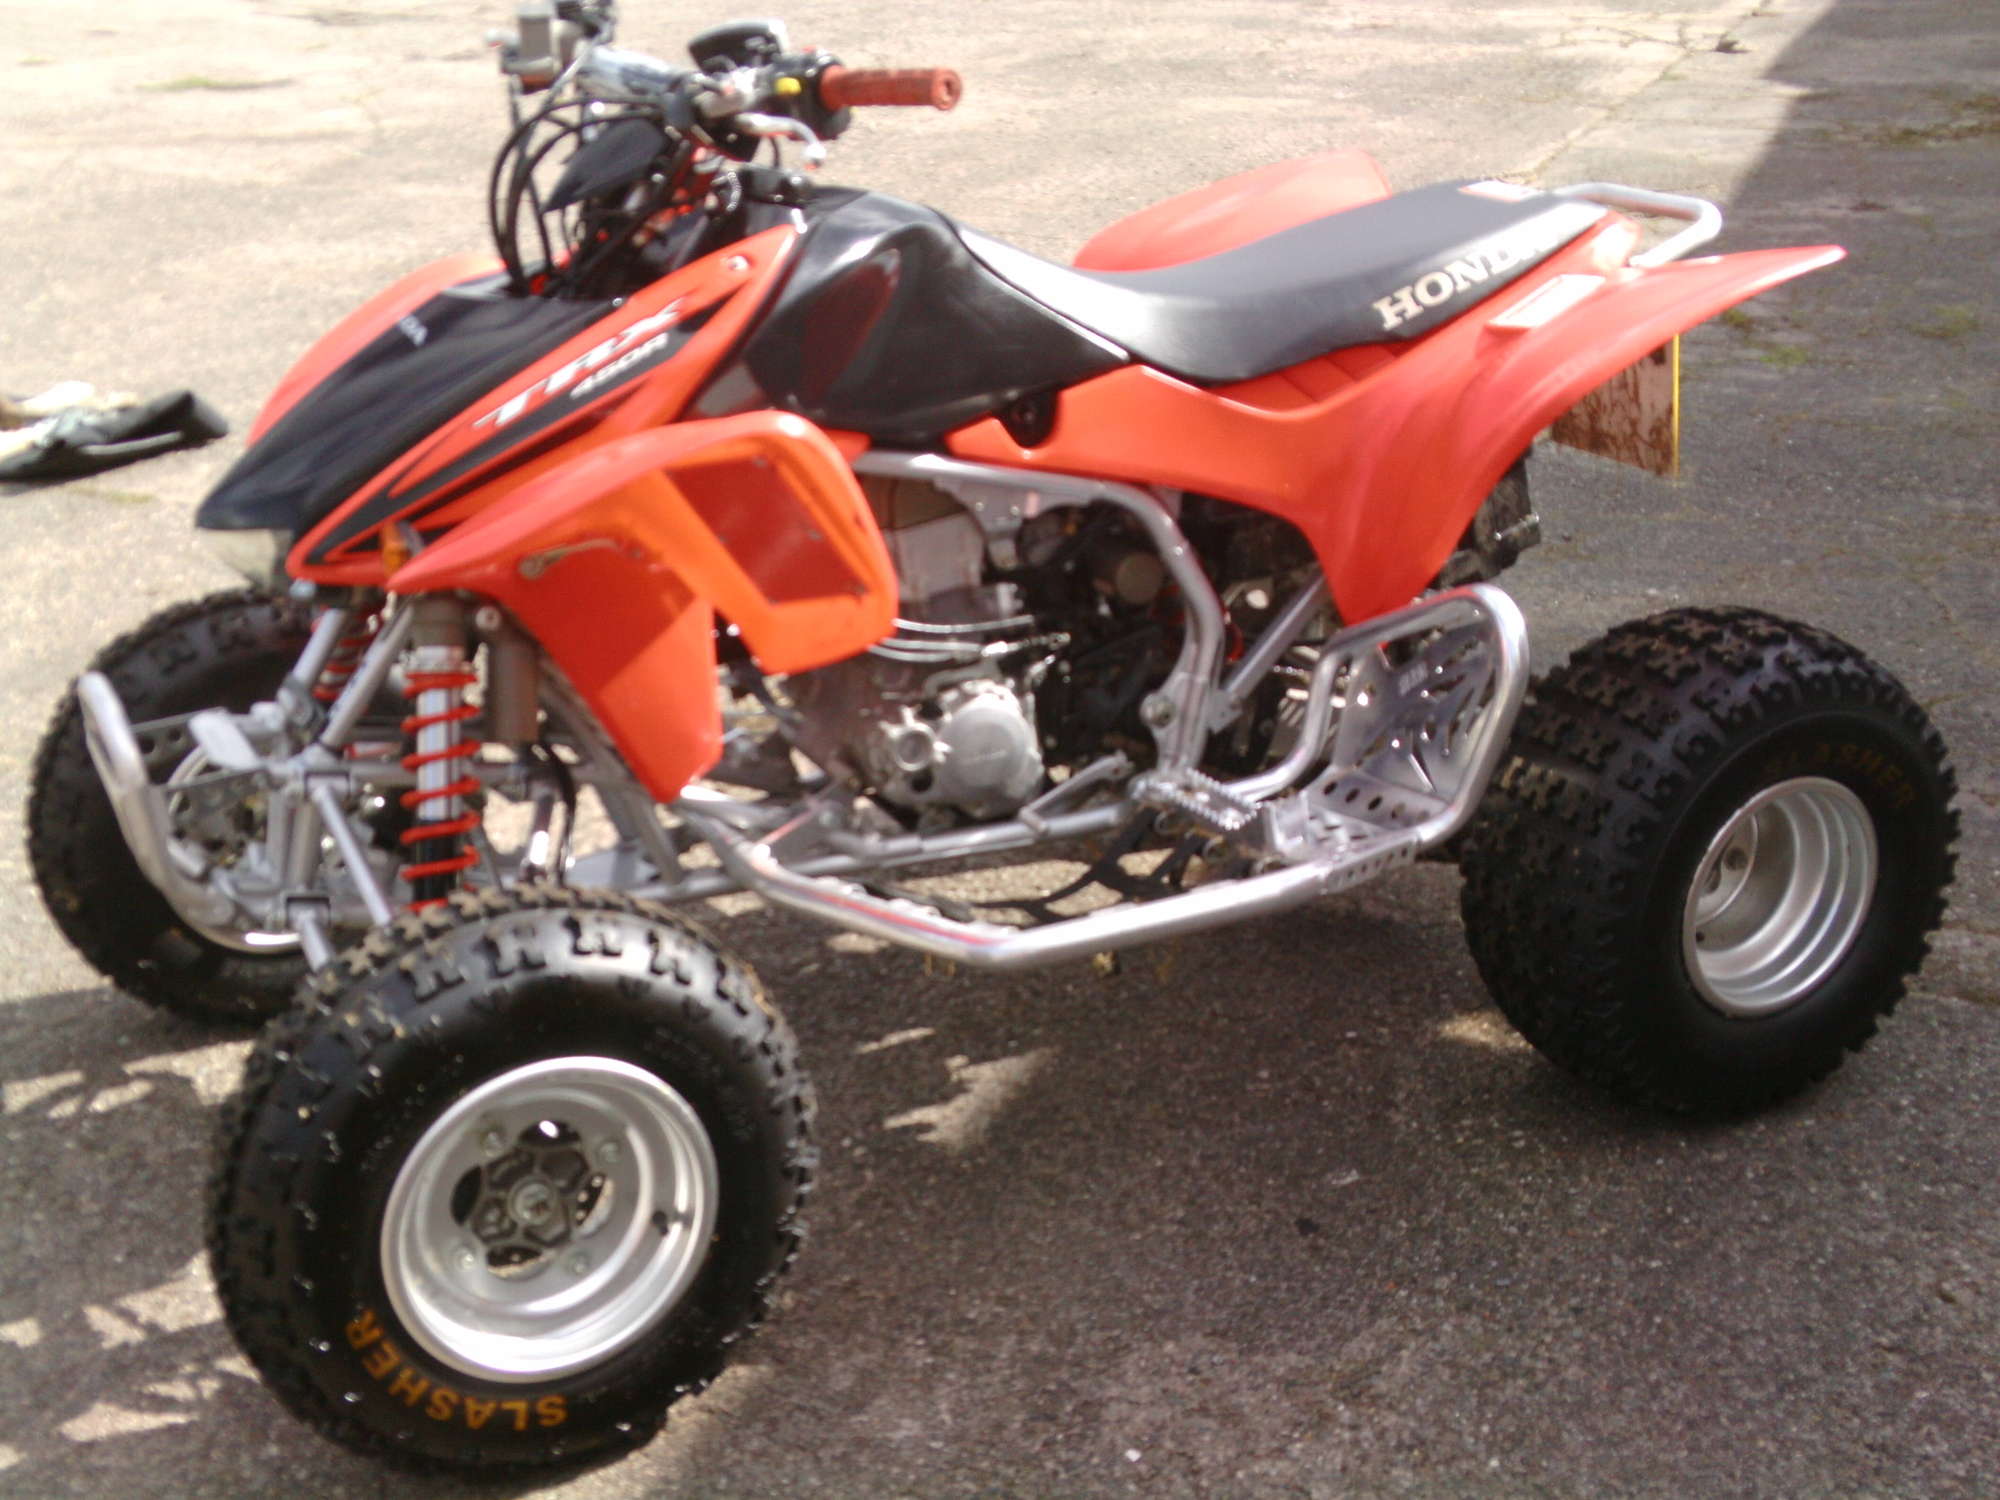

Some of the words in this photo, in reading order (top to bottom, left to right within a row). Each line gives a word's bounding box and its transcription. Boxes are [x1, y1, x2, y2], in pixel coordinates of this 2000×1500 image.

[1373, 224, 1556, 331] HOND
[472, 298, 684, 428] TRX
[345, 1308, 568, 1431] SLASHER
